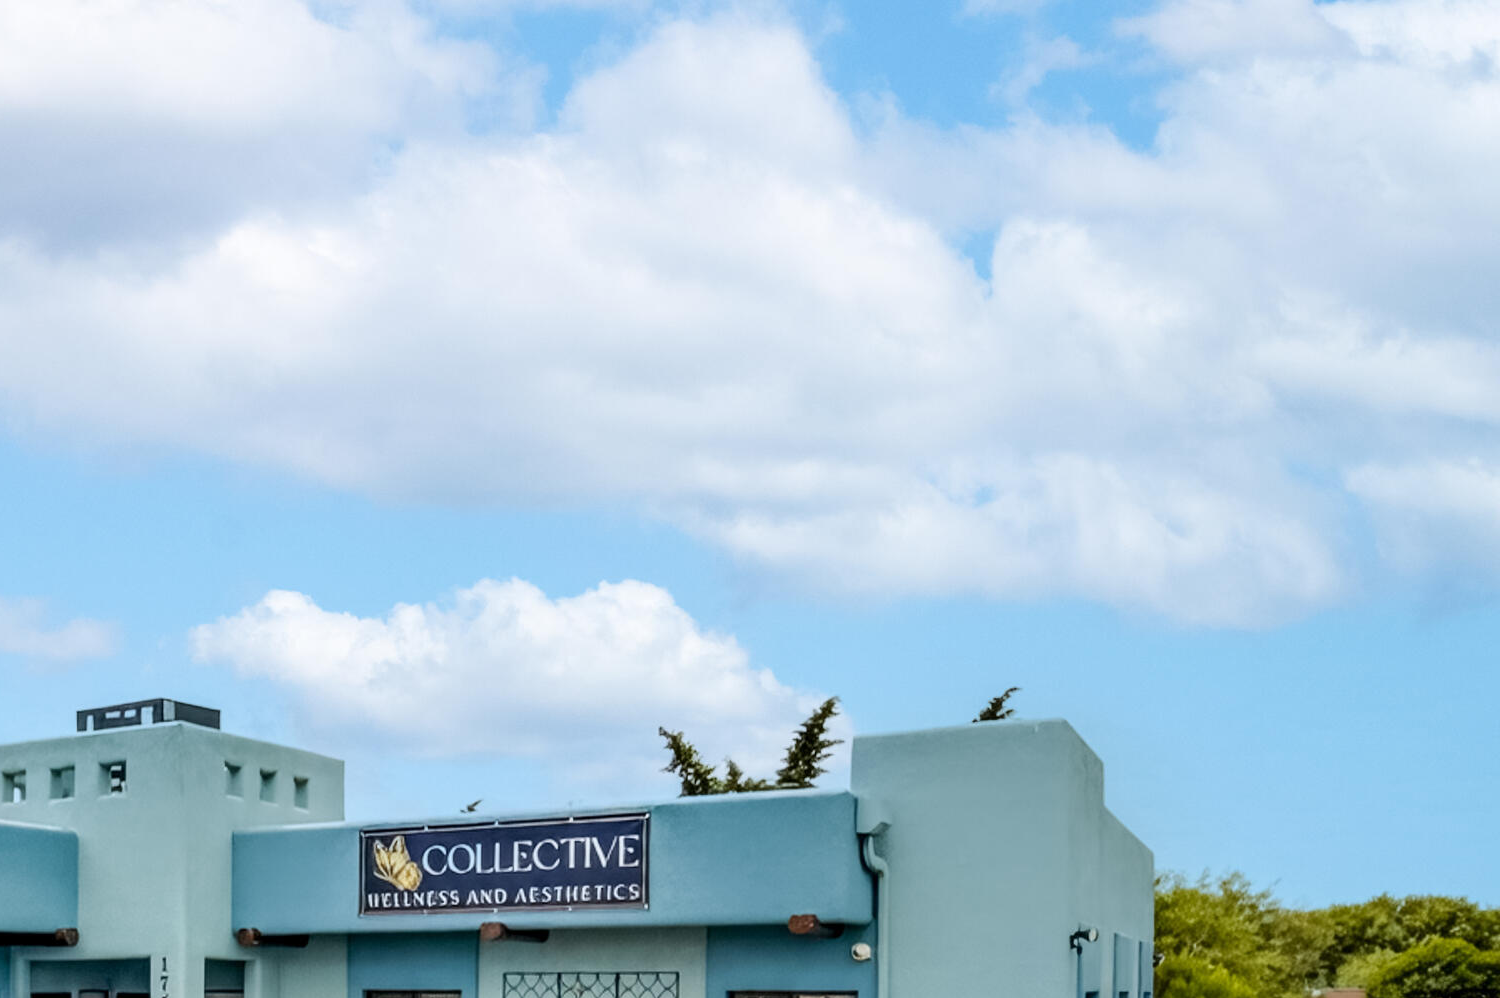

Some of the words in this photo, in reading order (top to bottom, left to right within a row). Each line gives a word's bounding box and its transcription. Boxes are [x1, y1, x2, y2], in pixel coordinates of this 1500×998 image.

[421, 834, 640, 876] COLLECTIVE
[466, 888, 508, 906] AND
[514, 883, 640, 904] AESTHETICS
